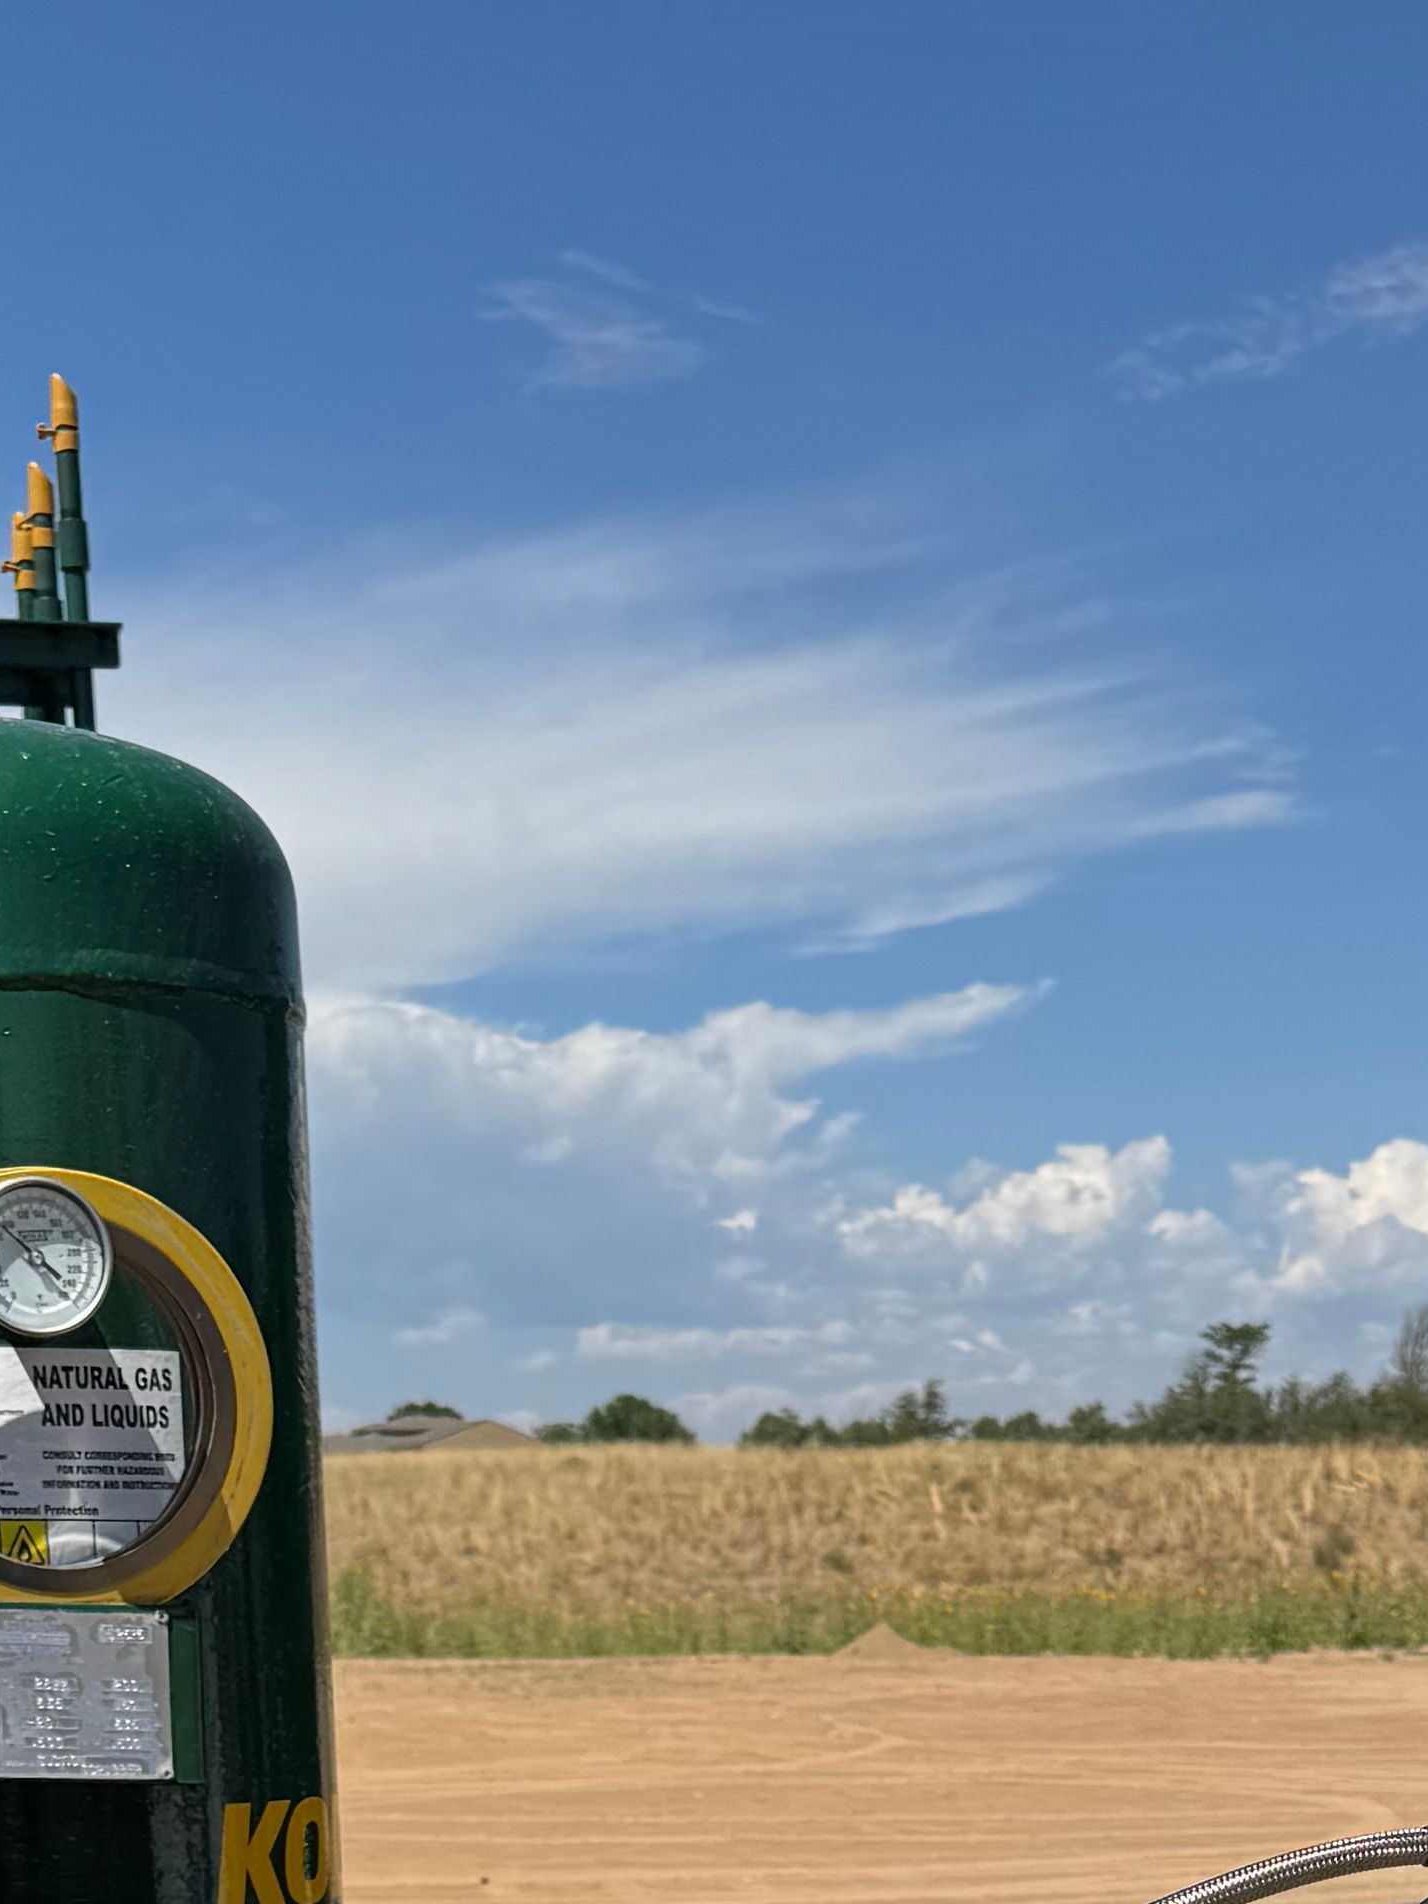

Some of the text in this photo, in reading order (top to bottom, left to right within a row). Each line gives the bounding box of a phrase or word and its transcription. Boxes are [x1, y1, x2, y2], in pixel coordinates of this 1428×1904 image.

[33, 1365, 172, 1391] NATURAL GAS
[42, 1403, 169, 1429] AND LIQUIDS
[44, 1505, 99, 1516] Protection
